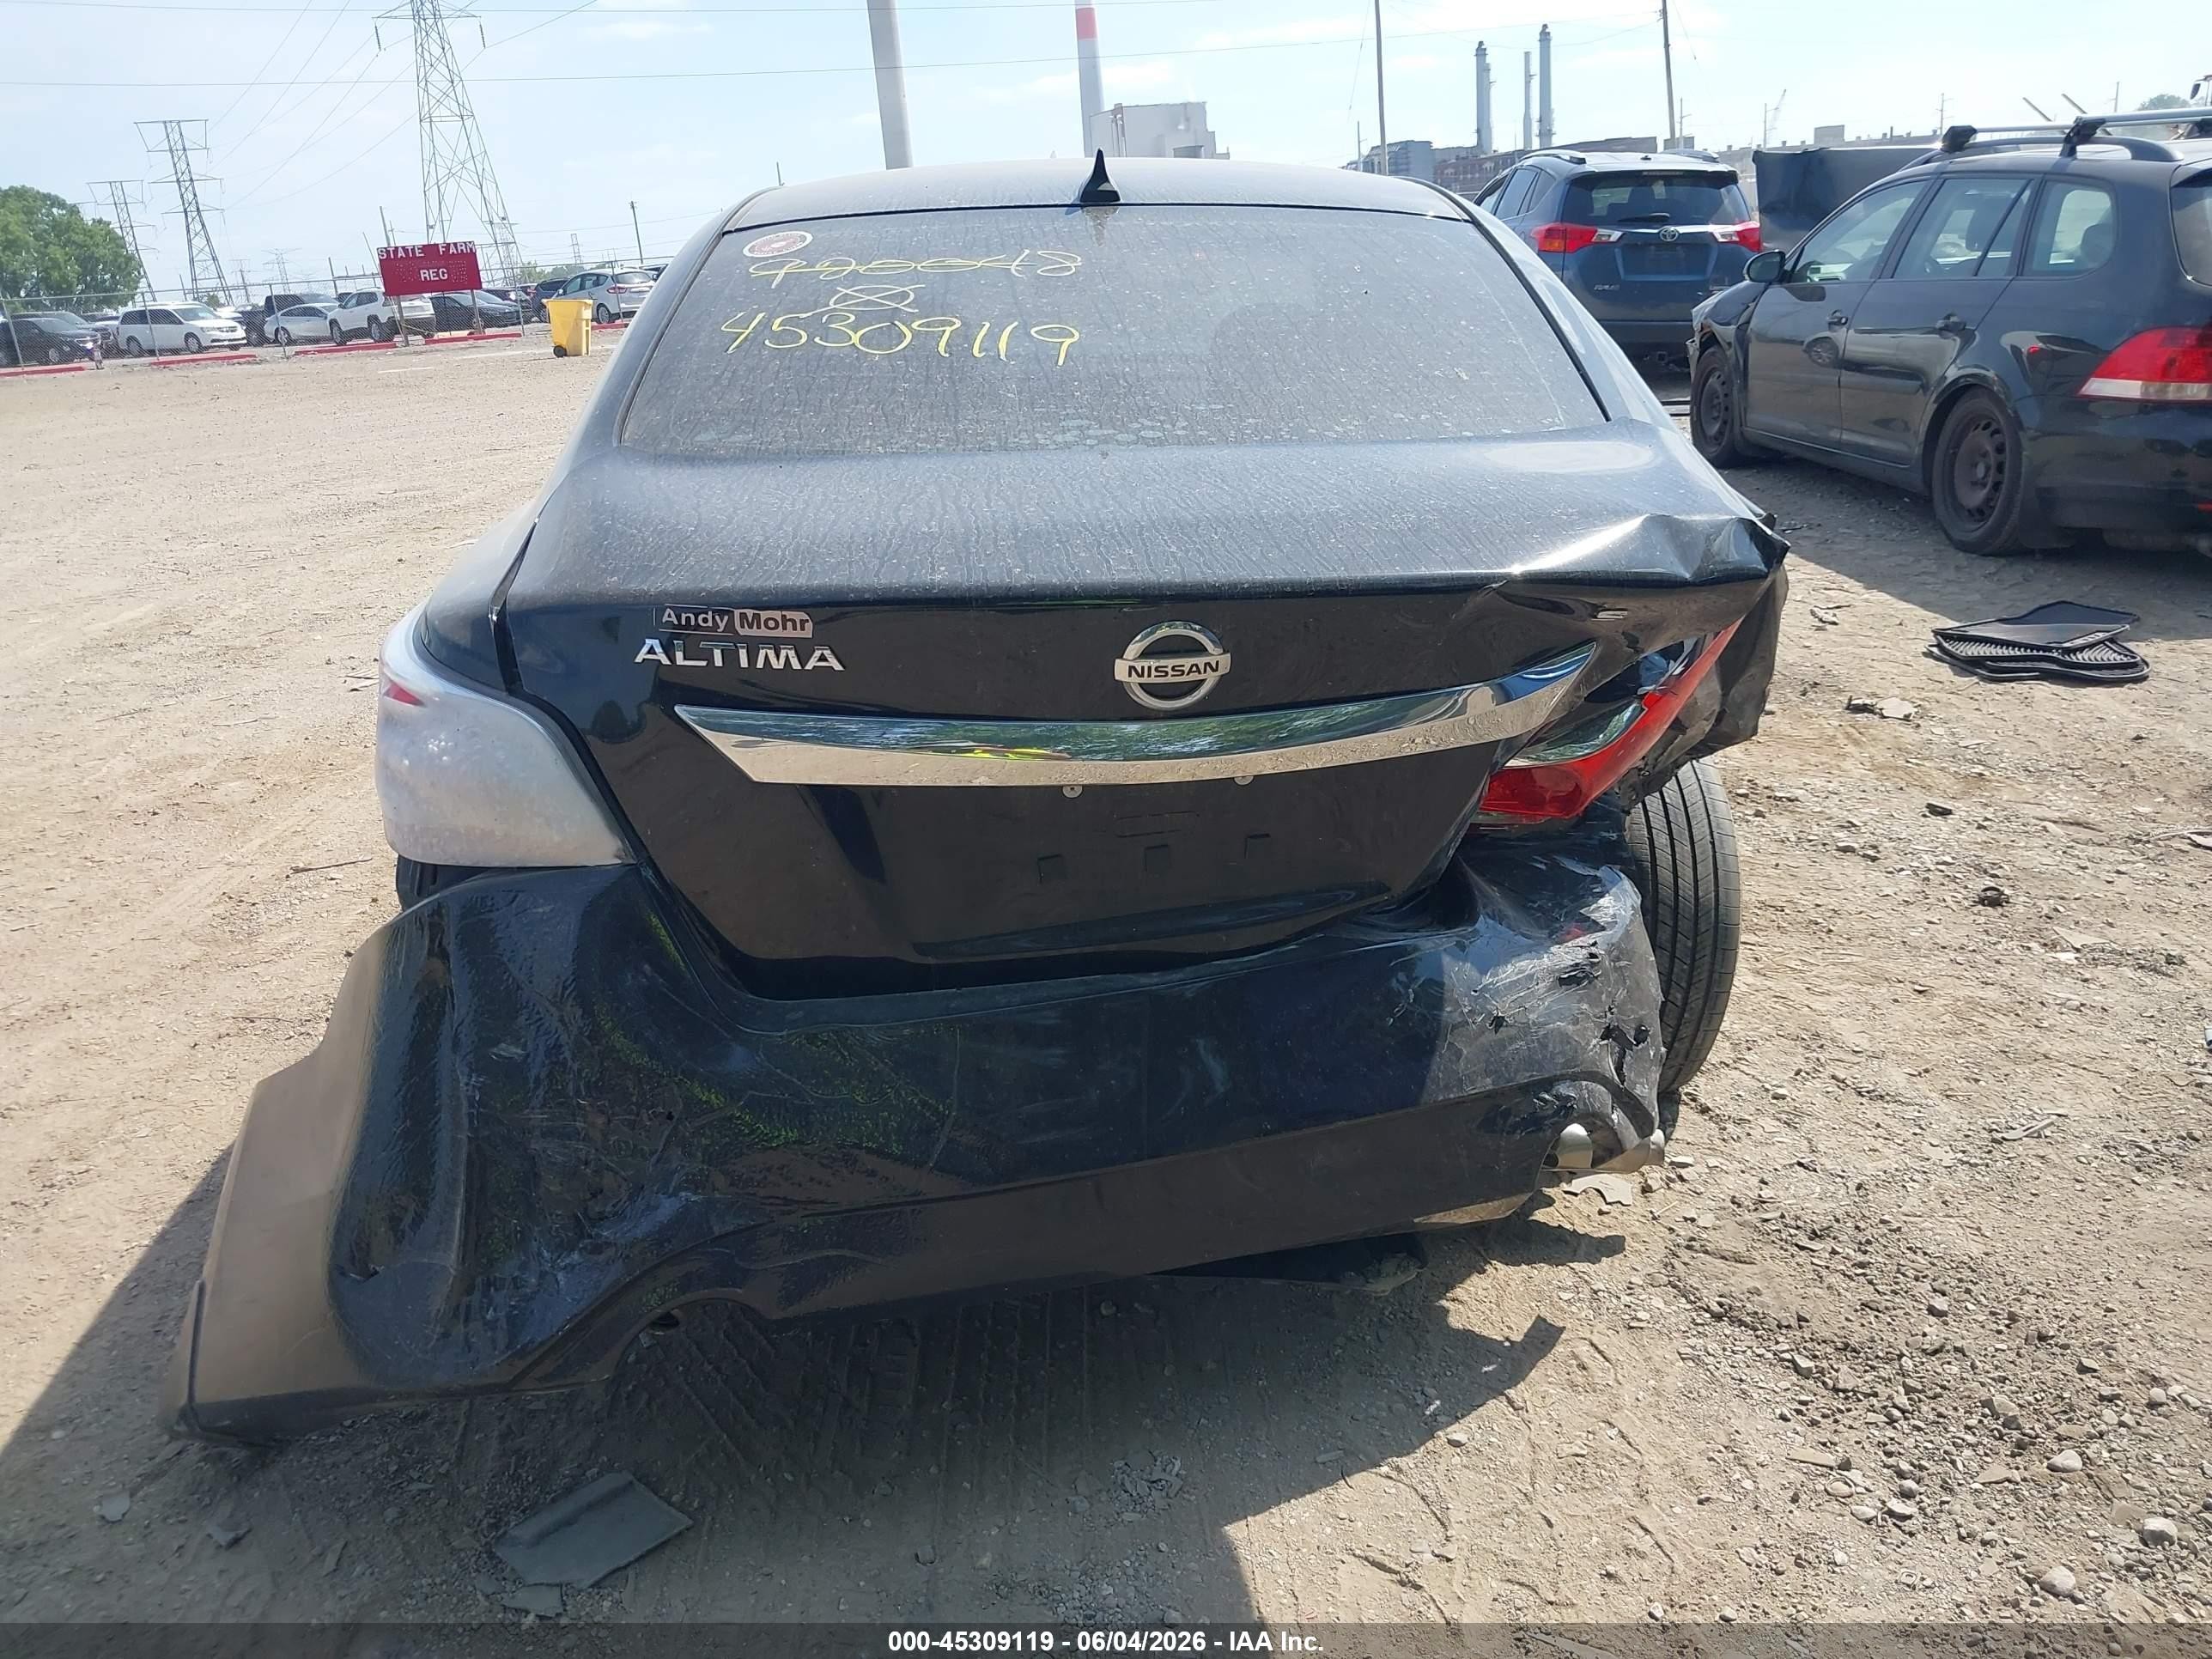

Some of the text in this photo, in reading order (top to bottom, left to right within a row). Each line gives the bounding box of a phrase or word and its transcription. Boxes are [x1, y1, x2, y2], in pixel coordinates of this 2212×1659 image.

[378, 241, 477, 259] STATE FARM
[420, 268, 448, 282] REG
[720, 311, 1080, 368] 45309119
[661, 608, 810, 633] Andy Mohr
[634, 638, 846, 672] ALTIMA
[1127, 659, 1219, 678] NISSAN
